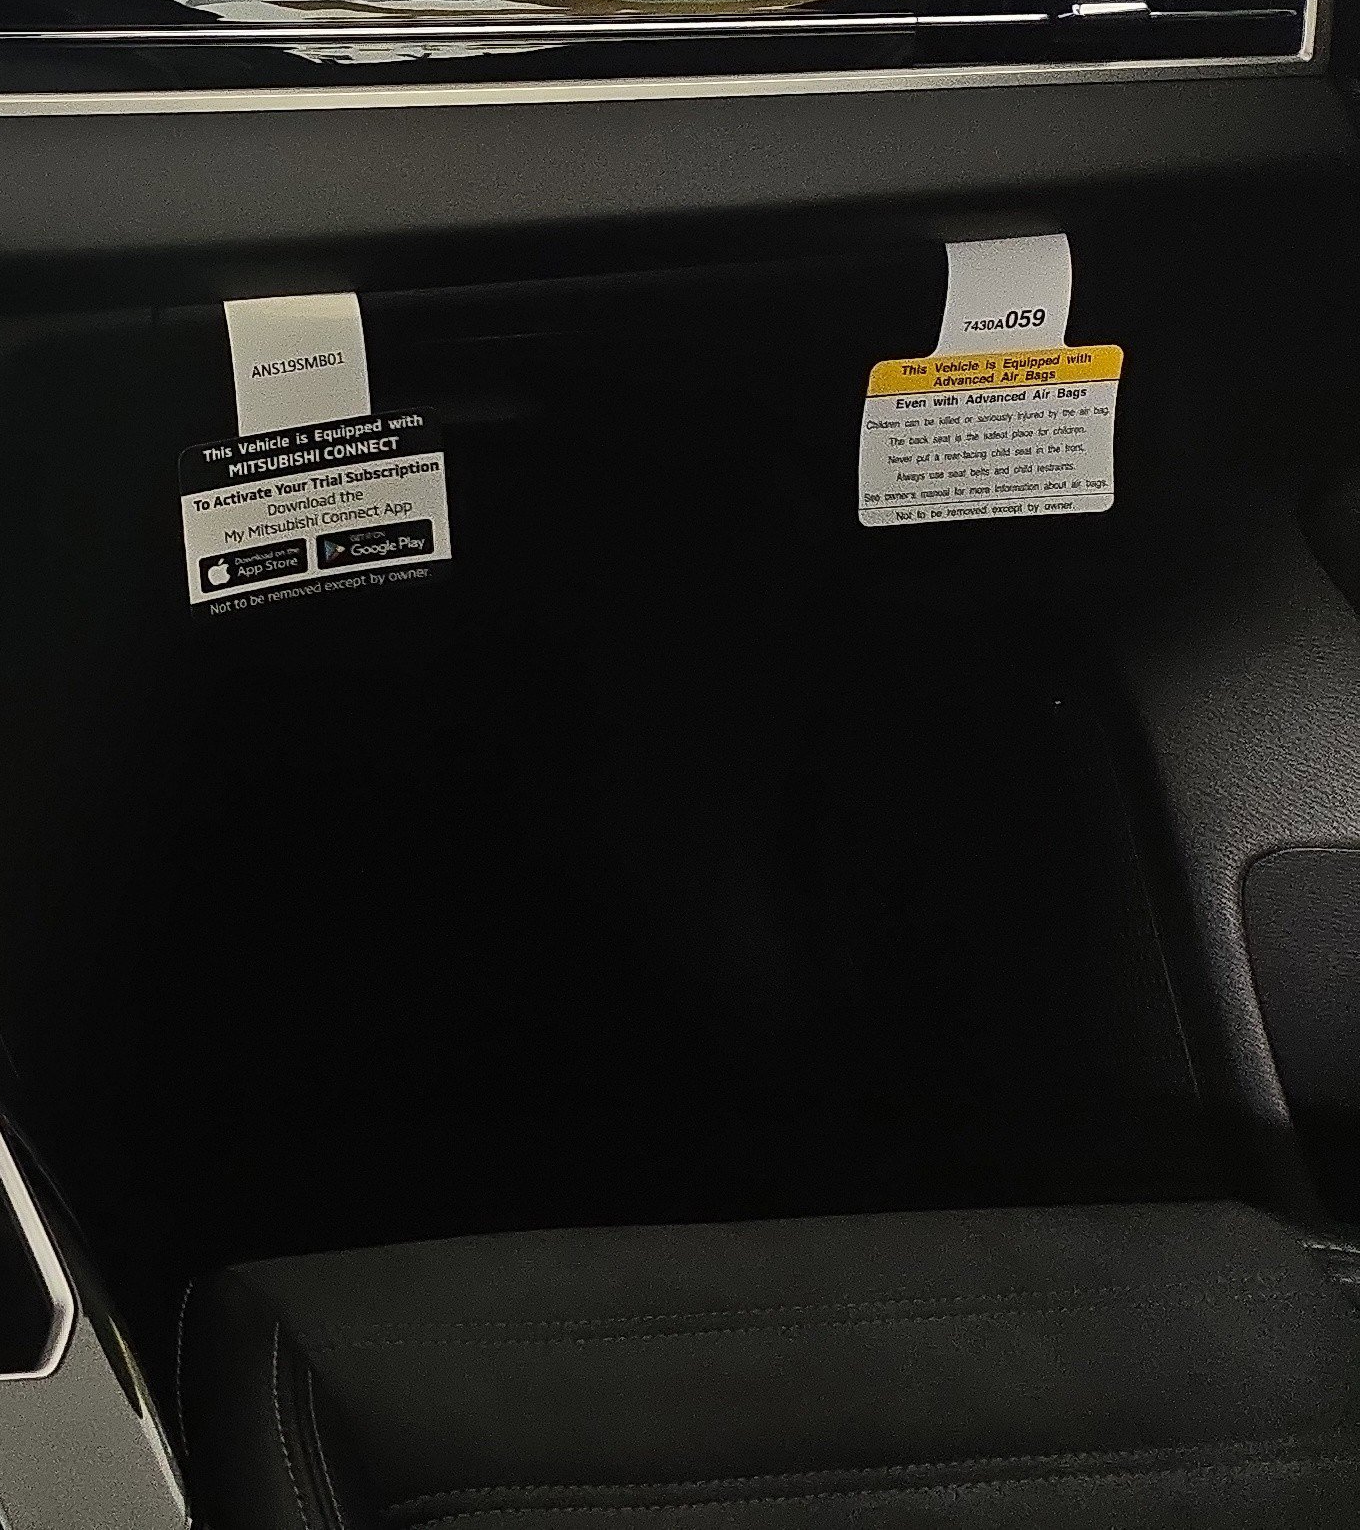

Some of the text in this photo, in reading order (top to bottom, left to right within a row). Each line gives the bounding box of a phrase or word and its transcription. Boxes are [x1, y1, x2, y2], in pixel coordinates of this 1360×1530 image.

[963, 308, 1046, 333] 7430A059
[251, 351, 346, 379] ANS19SMB01
[901, 352, 1092, 376] This Vehicle is Equipped with
[932, 369, 1056, 388] Advanced Air Bags
[895, 386, 1087, 410] Even with Advanced Air Bags
[202, 411, 423, 462] This Vehicle is Equipped with
[227, 436, 400, 478] MITSUBISHI CONNECT
[193, 460, 439, 512] To Activate Your Trial Subscription
[267, 487, 363, 517] Download the
[223, 498, 412, 544] My Mitsubishi Connect App
[349, 541, 397, 556] Google
[397, 533, 426, 552] Play
[236, 555, 298, 577] App Store
[210, 600, 231, 614] Not
[233, 597, 247, 609] to
[249, 594, 265, 606] be
[267, 582, 322, 602] removed
[324, 575, 367, 594] except
[369, 572, 386, 586] by
